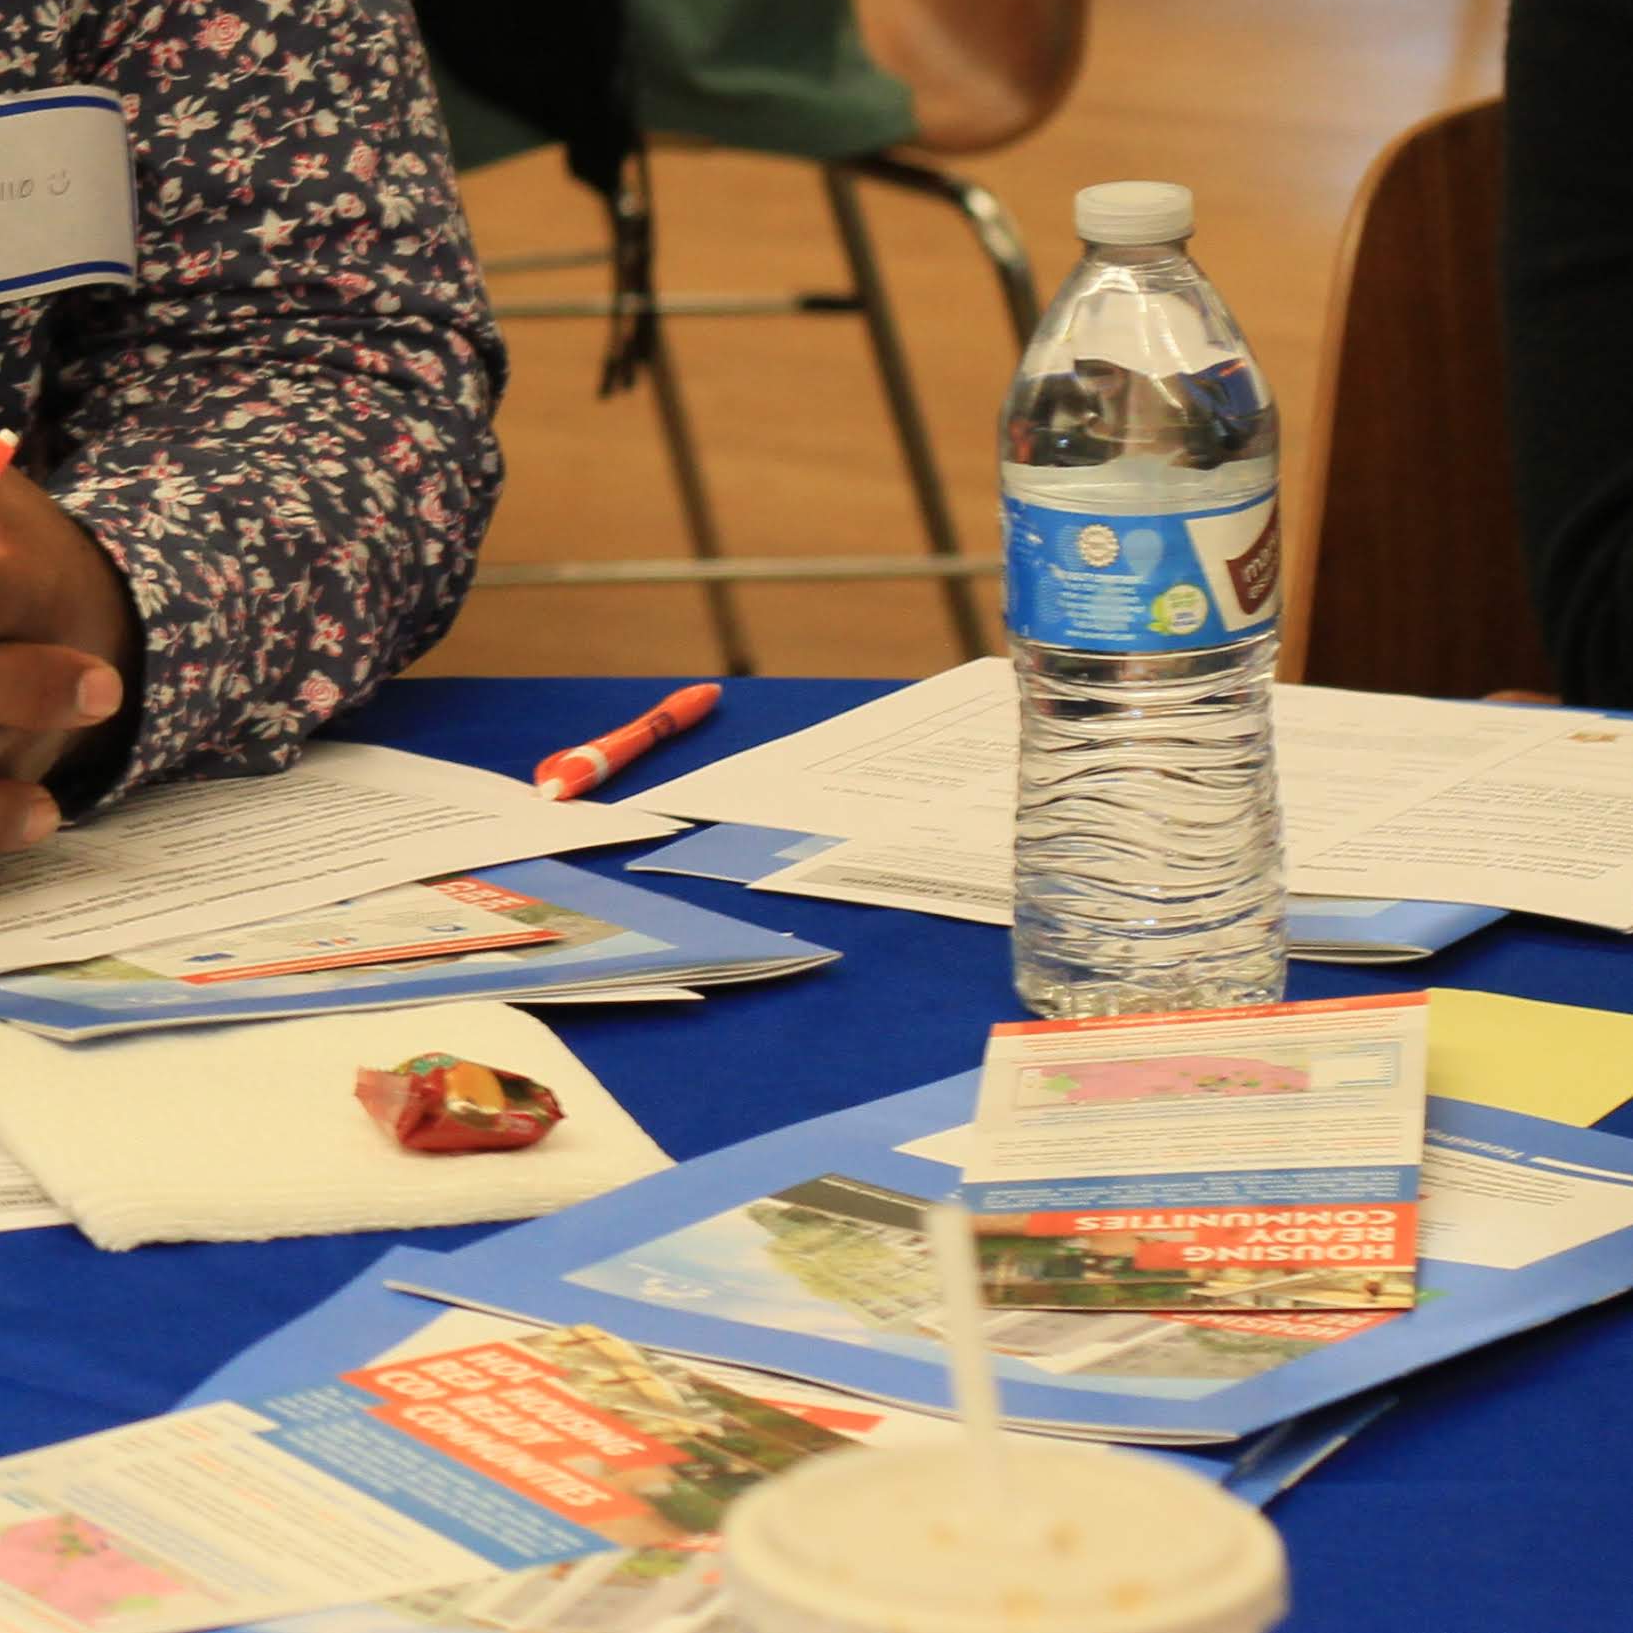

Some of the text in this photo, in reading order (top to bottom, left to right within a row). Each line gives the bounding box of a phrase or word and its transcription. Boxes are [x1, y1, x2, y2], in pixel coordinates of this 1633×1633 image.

[1073, 1208, 1398, 1233] COMMUNITIES
[1245, 1226, 1397, 1244] READY
[1181, 1244, 1395, 1264] HOUSING
[446, 1393, 567, 1446] READY
[495, 1386, 648, 1457] HOUSING
[400, 1403, 616, 1508] COMMUNITIES
